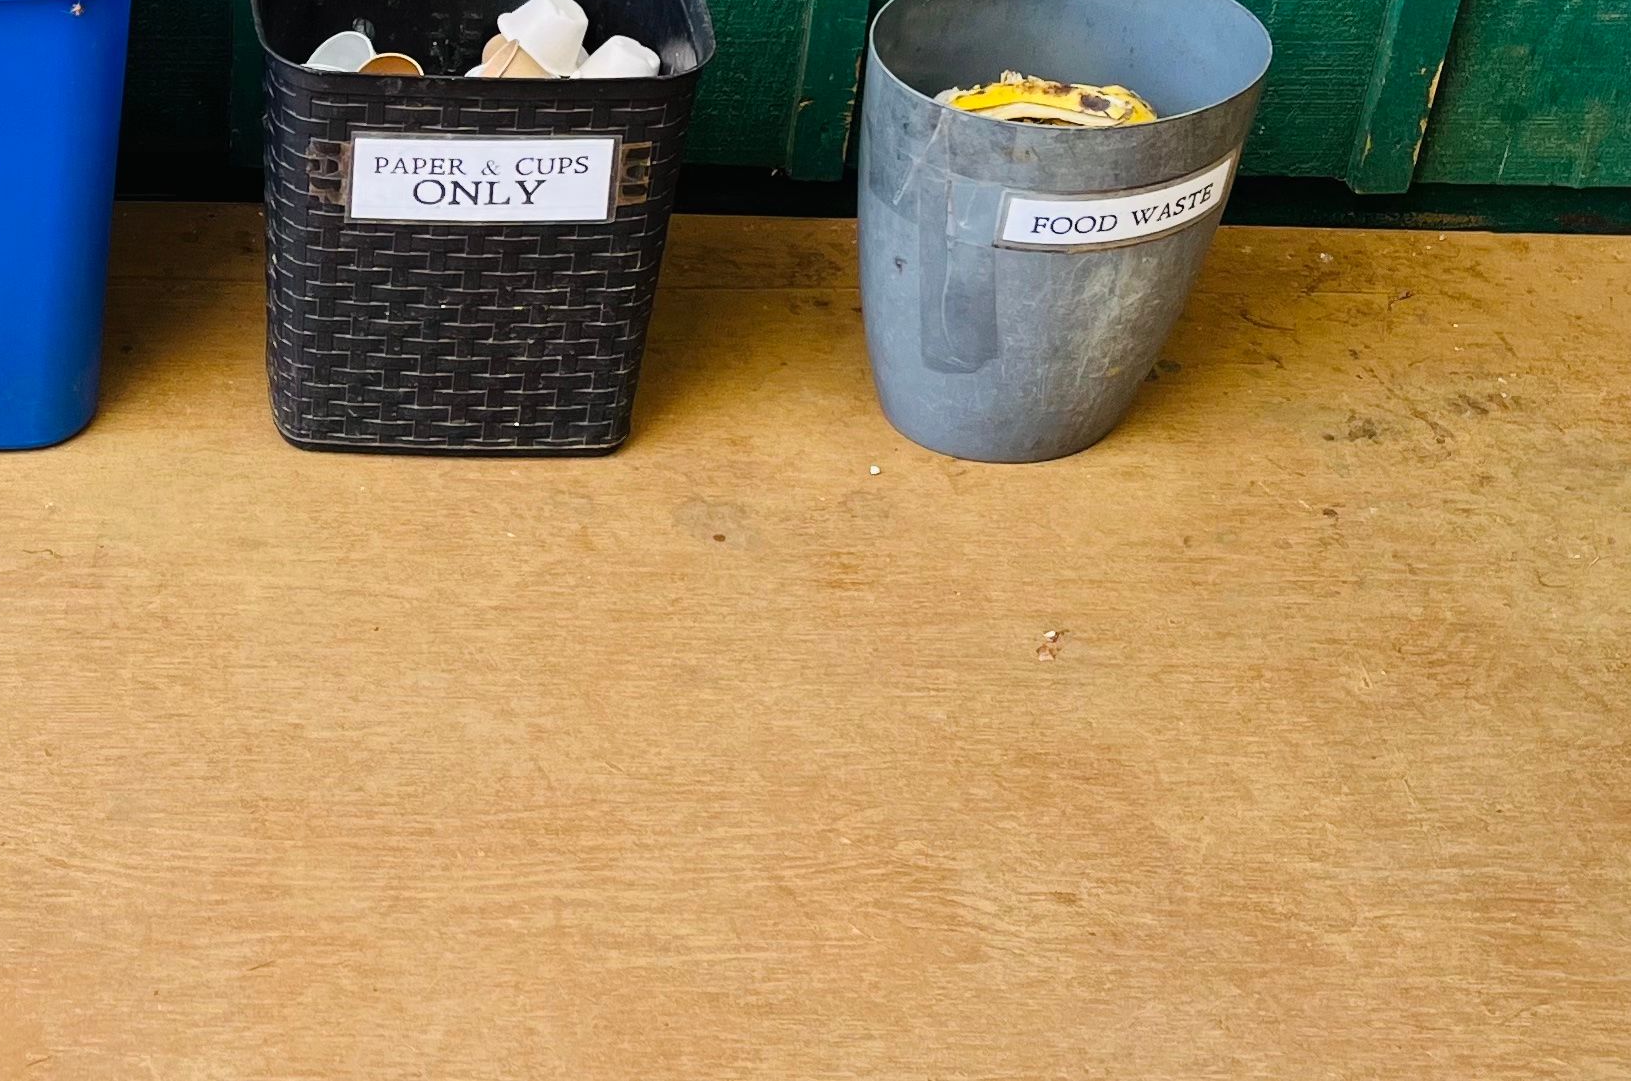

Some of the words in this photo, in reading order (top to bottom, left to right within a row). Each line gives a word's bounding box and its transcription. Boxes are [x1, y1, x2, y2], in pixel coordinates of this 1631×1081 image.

[374, 156, 467, 176] PAPER
[480, 159, 502, 176] &
[515, 155, 590, 175] CUPS
[412, 179, 547, 206] ONLY
[1030, 214, 1118, 235] FOOD
[1130, 182, 1215, 227] WASTE
